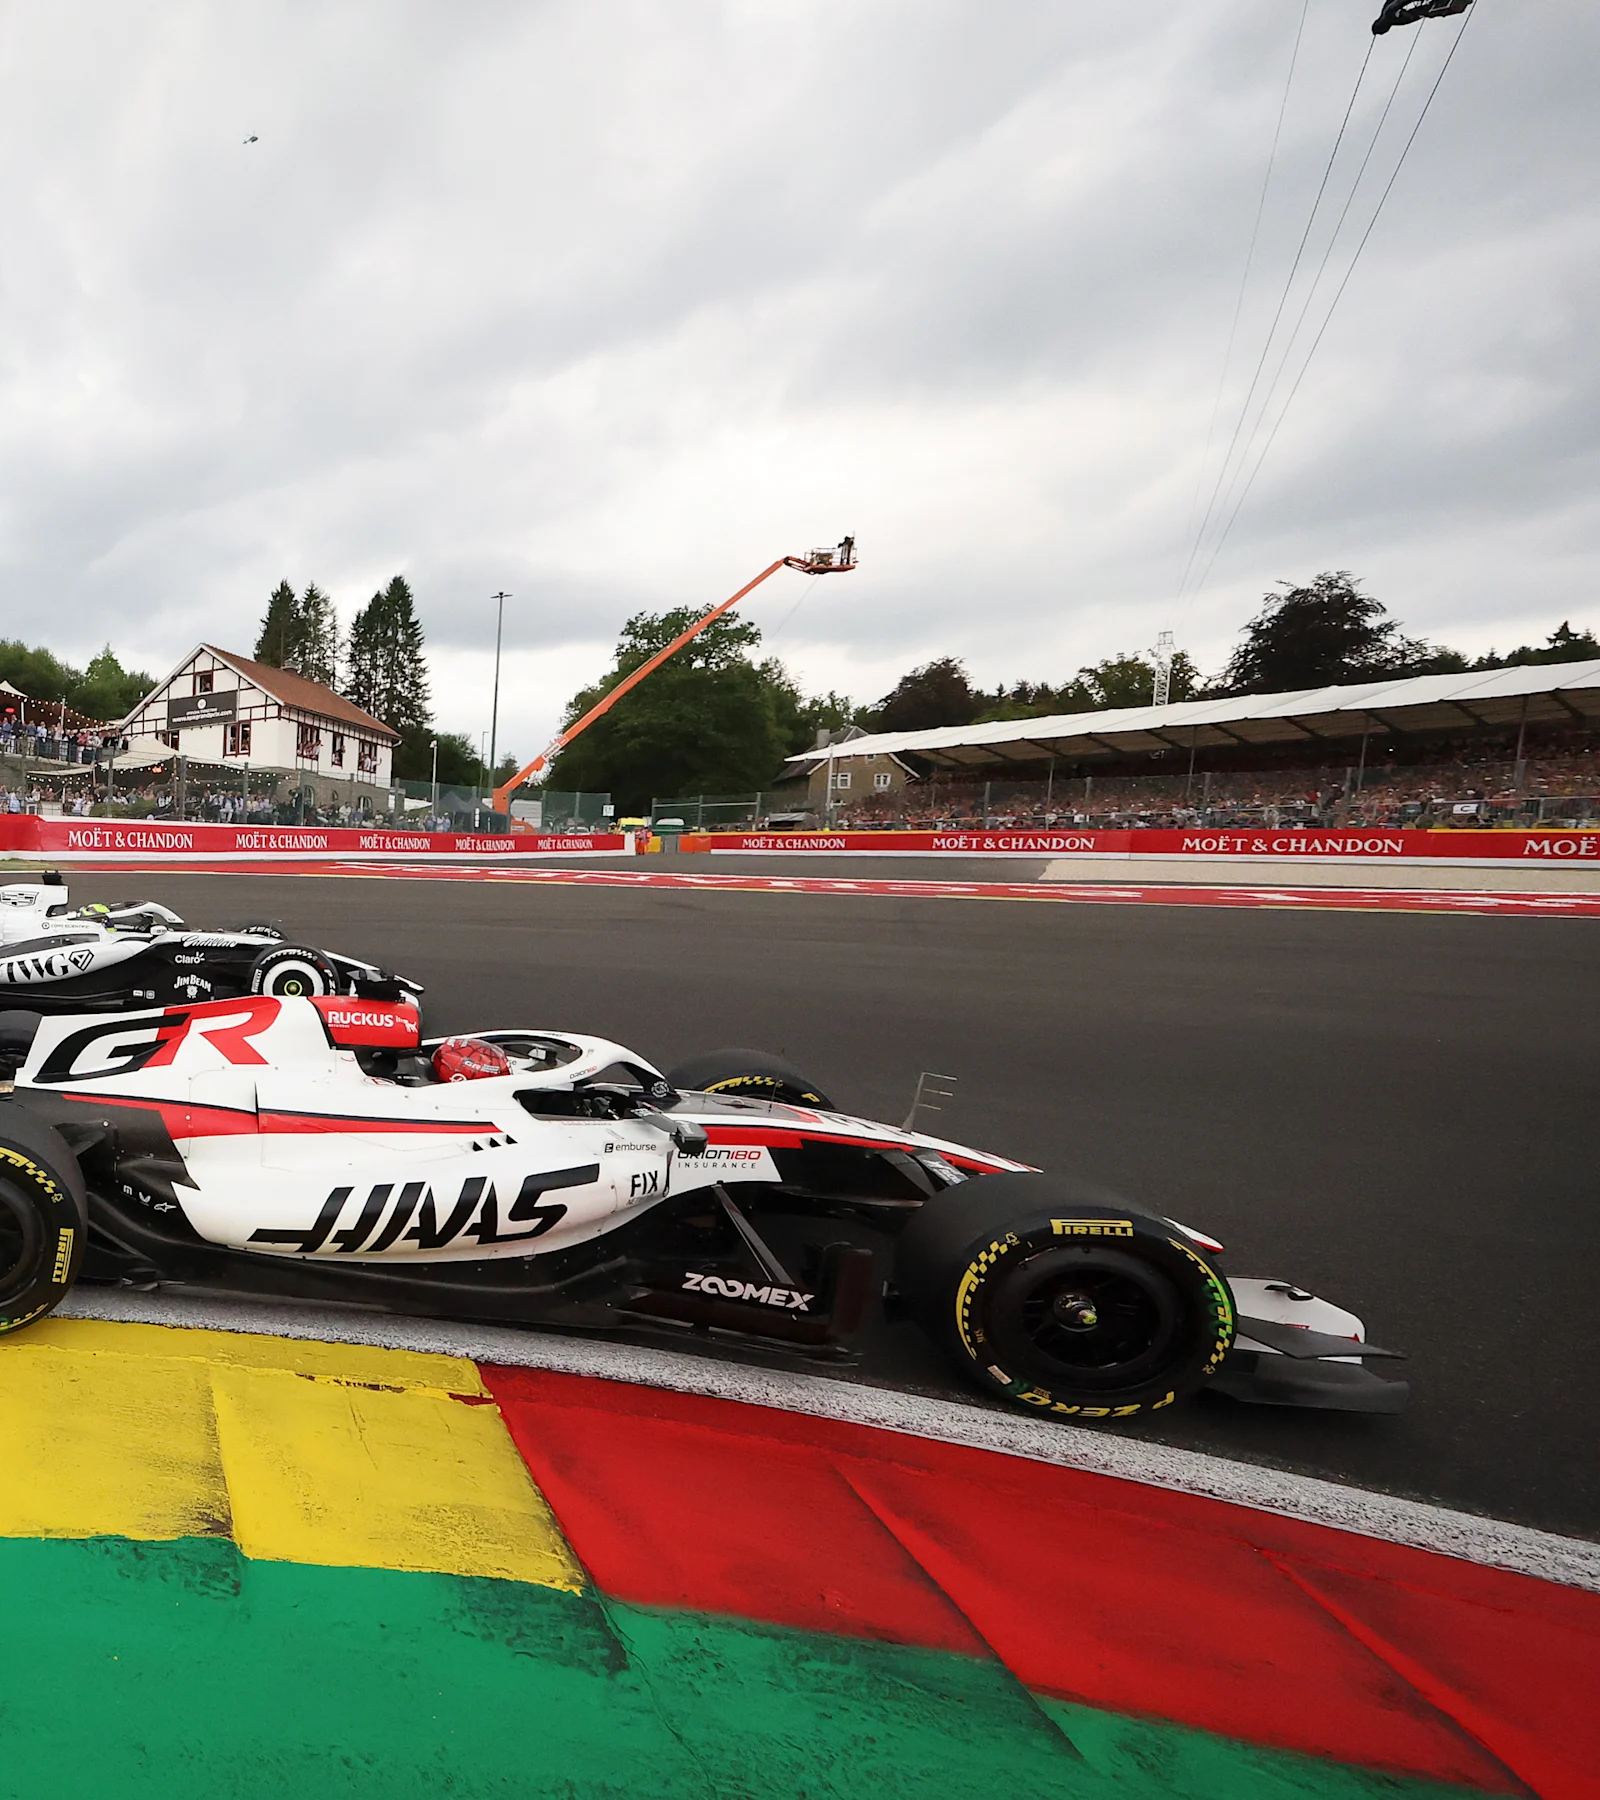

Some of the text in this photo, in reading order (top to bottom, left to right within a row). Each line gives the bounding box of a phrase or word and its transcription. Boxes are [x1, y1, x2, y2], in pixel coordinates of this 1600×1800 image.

[68, 827, 193, 849] MOËT & CHANDON
[236, 831, 328, 849] MOËT & CHANDON
[359, 834, 431, 850] MOËT & CHANDON
[456, 836, 477, 851] MOËT
[482, 838, 515, 851] CHANDON
[538, 837, 557, 849] MOËT
[563, 838, 593, 849] CHANDON
[742, 837, 846, 849] MOËT & CHANDON
[932, 836, 1095, 850] MOËT & CHANDON
[1182, 836, 1404, 854] MOËT & CHANDON
[181, 935, 239, 947] Cadillac
[250, 926, 281, 938] ZERO
[175, 953, 202, 964] Claro
[0, 953, 69, 983] TWG
[174, 974, 212, 992] JIM BEAM
[328, 1011, 394, 1027] RUCKUS
[32, 995, 282, 1083] GR
[615, 1142, 657, 1151] emburse
[630, 1170, 659, 1197] FIX
[246, 1163, 600, 1253] HAAS
[1050, 1218, 1134, 1237] PIRELLI
[52, 1227, 74, 1284] PIRELLI
[682, 1272, 815, 1312] ZOOMEX
[1016, 1391, 1141, 1418] ZERO
[1152, 1391, 1175, 1409] P
